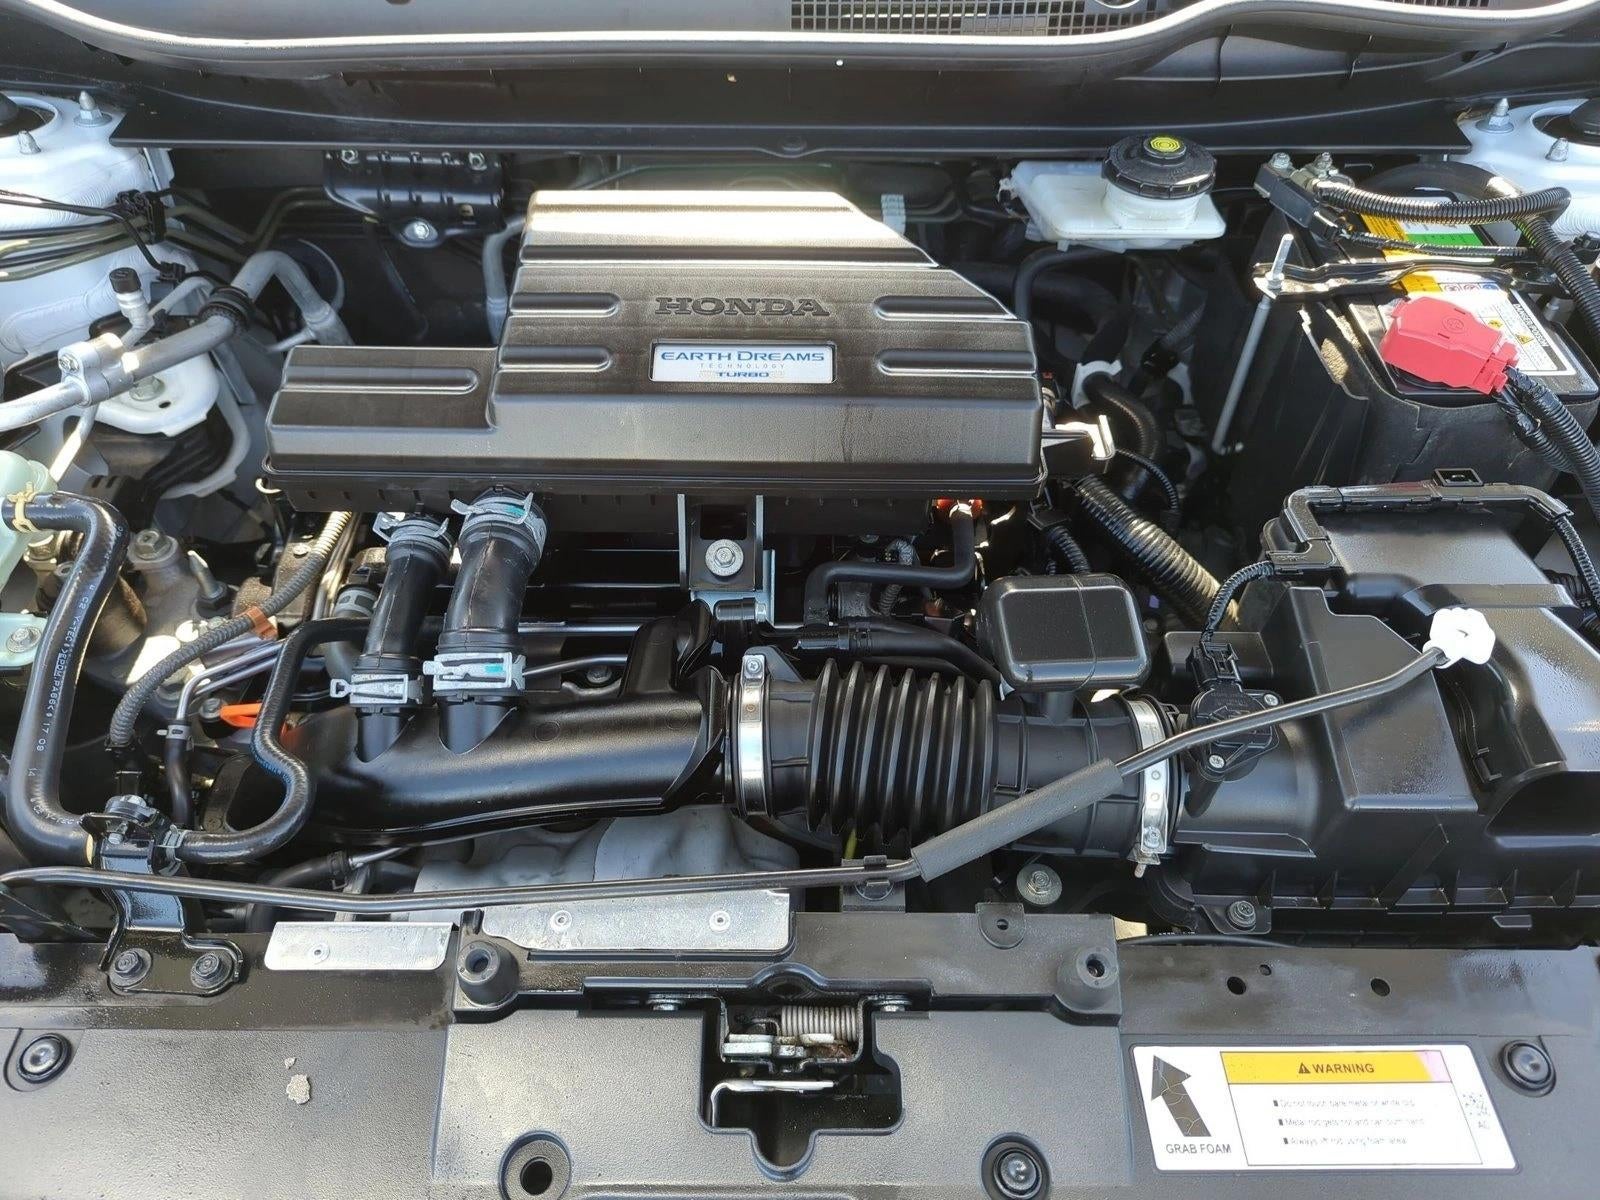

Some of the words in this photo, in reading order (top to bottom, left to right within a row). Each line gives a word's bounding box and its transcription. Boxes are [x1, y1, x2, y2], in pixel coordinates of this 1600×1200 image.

[655, 297, 830, 316] HONDA
[661, 352, 732, 361] EARTH
[738, 351, 825, 361] DREAMS
[1313, 1063, 1375, 1074] WARNING
[1166, 1143, 1198, 1154] GRAB
[1199, 1143, 1232, 1154] FOAM
